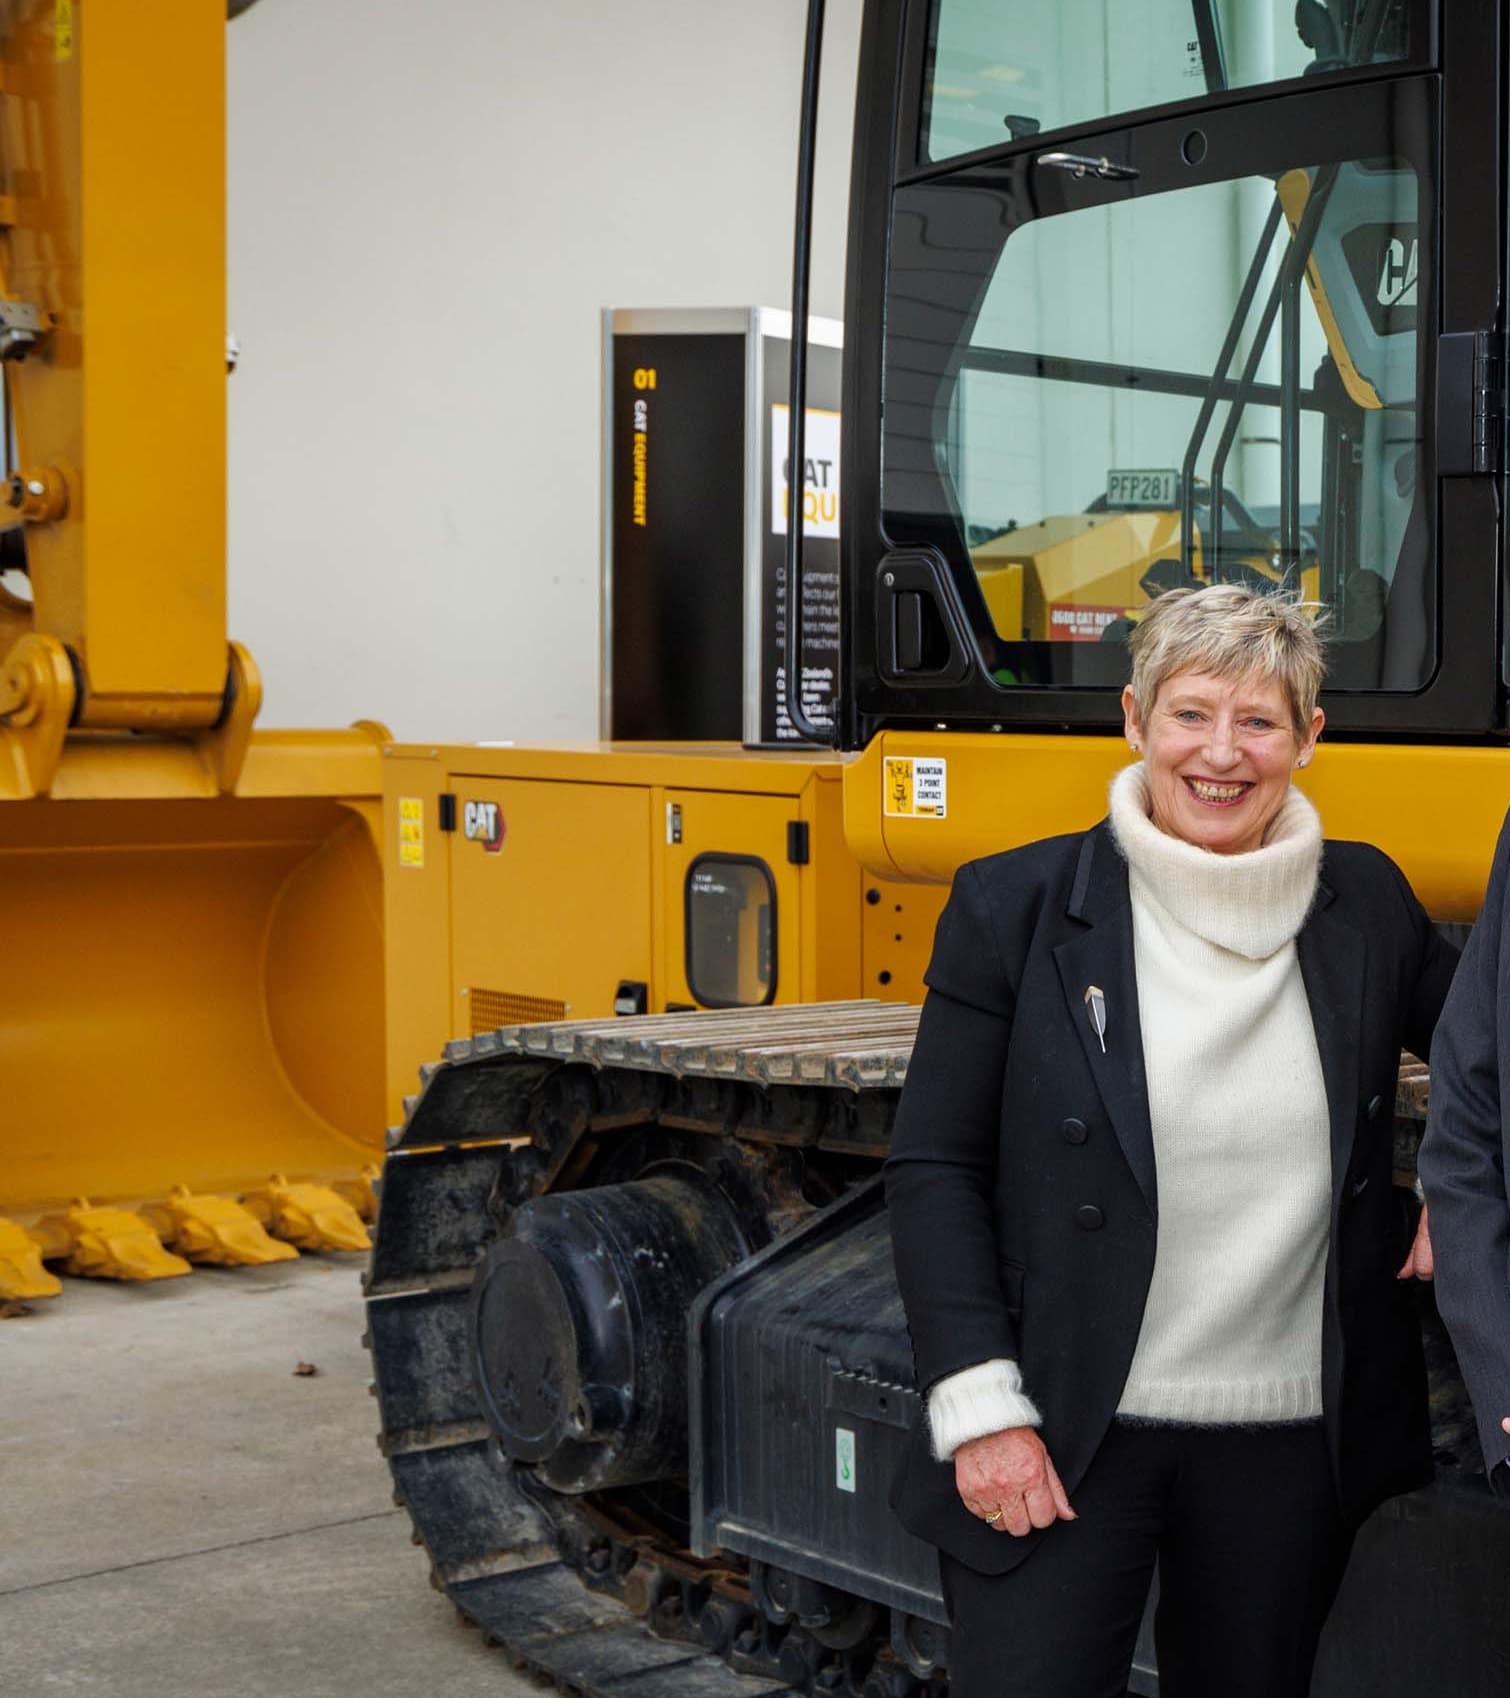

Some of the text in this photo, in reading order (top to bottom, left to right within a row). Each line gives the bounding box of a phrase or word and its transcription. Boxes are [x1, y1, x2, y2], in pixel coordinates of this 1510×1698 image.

[633, 368, 656, 390] 01
[633, 400, 647, 527] CAT EQUIPMENT
[1110, 476, 1170, 500] PFP281
[916, 766, 943, 775] MAINTAIN
[924, 778, 940, 787] POINT
[917, 790, 941, 799] CONTACT
[464, 802, 497, 840] CAT
